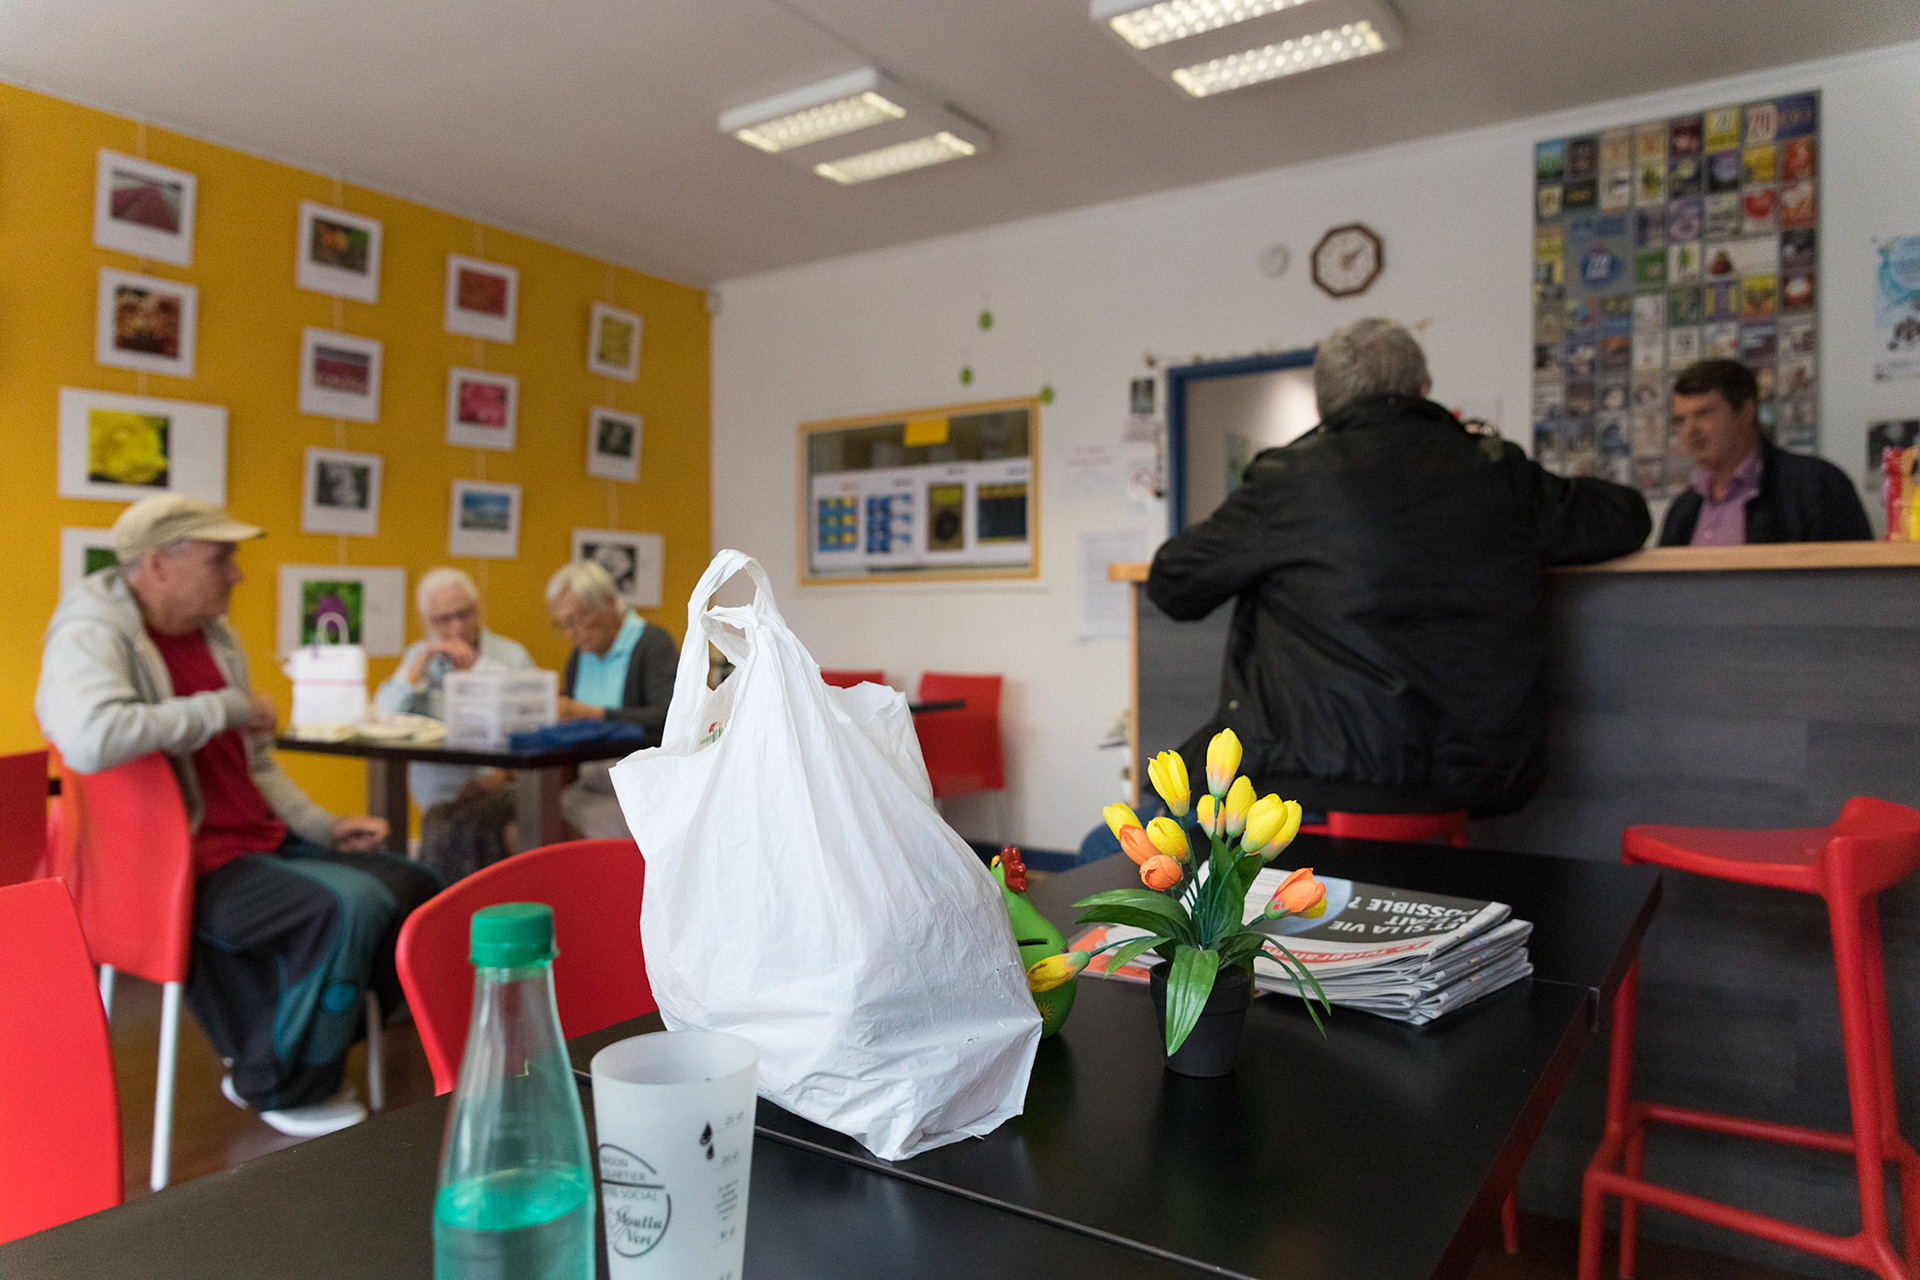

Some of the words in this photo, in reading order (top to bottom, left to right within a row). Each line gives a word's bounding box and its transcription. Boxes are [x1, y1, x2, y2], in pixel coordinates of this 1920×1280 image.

[1366, 898, 1480, 918] POSSIBLE
[1327, 920, 1367, 933] VIE
[1372, 924, 1402, 935] LA
[1403, 923, 1428, 934] SI
